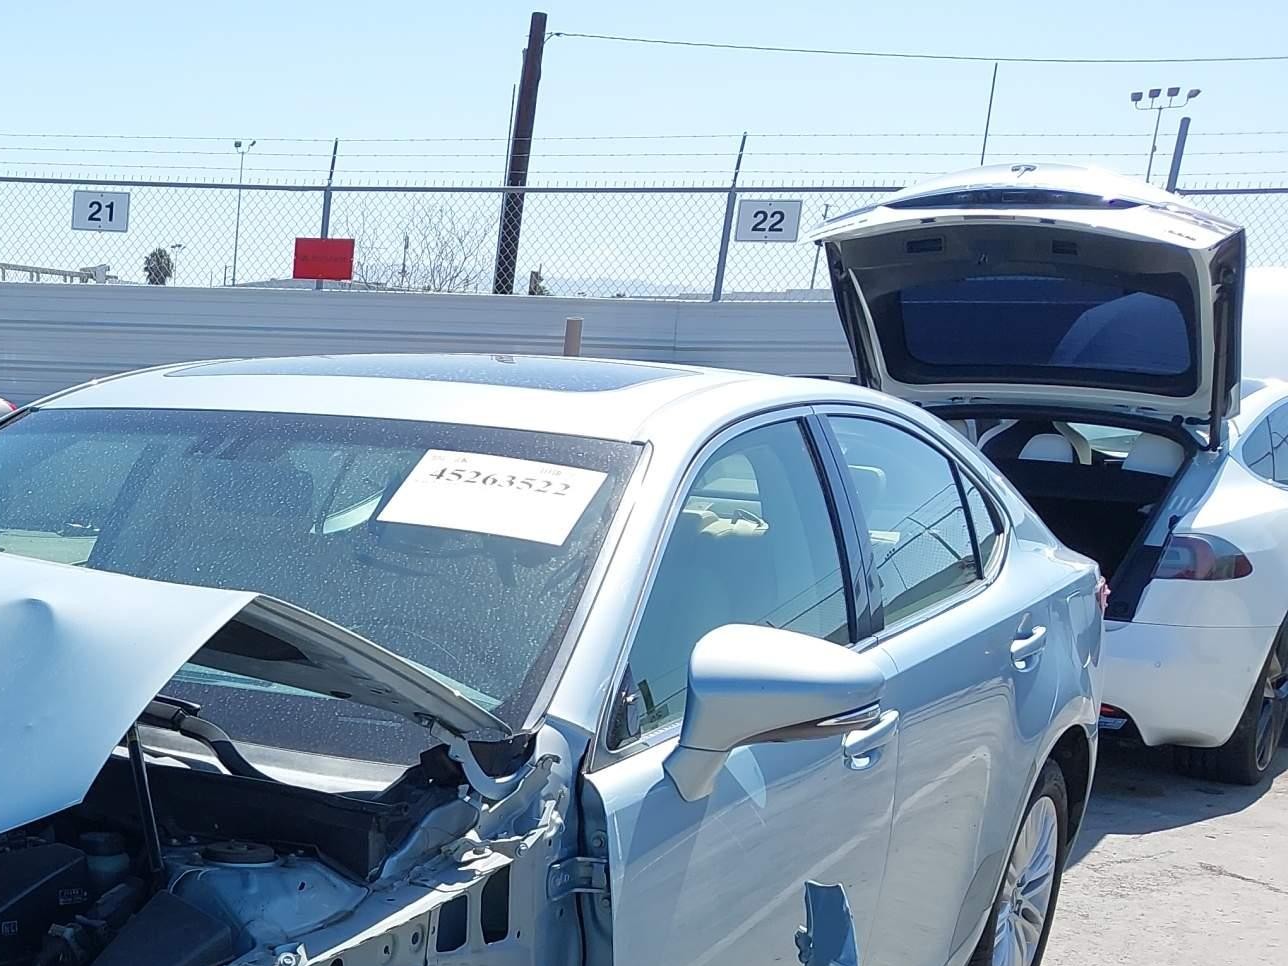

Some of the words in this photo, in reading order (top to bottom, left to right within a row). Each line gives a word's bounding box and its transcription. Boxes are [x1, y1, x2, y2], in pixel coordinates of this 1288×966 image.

[87, 200, 114, 222] 21
[751, 210, 785, 232] 22
[428, 467, 571, 496] 45263522
